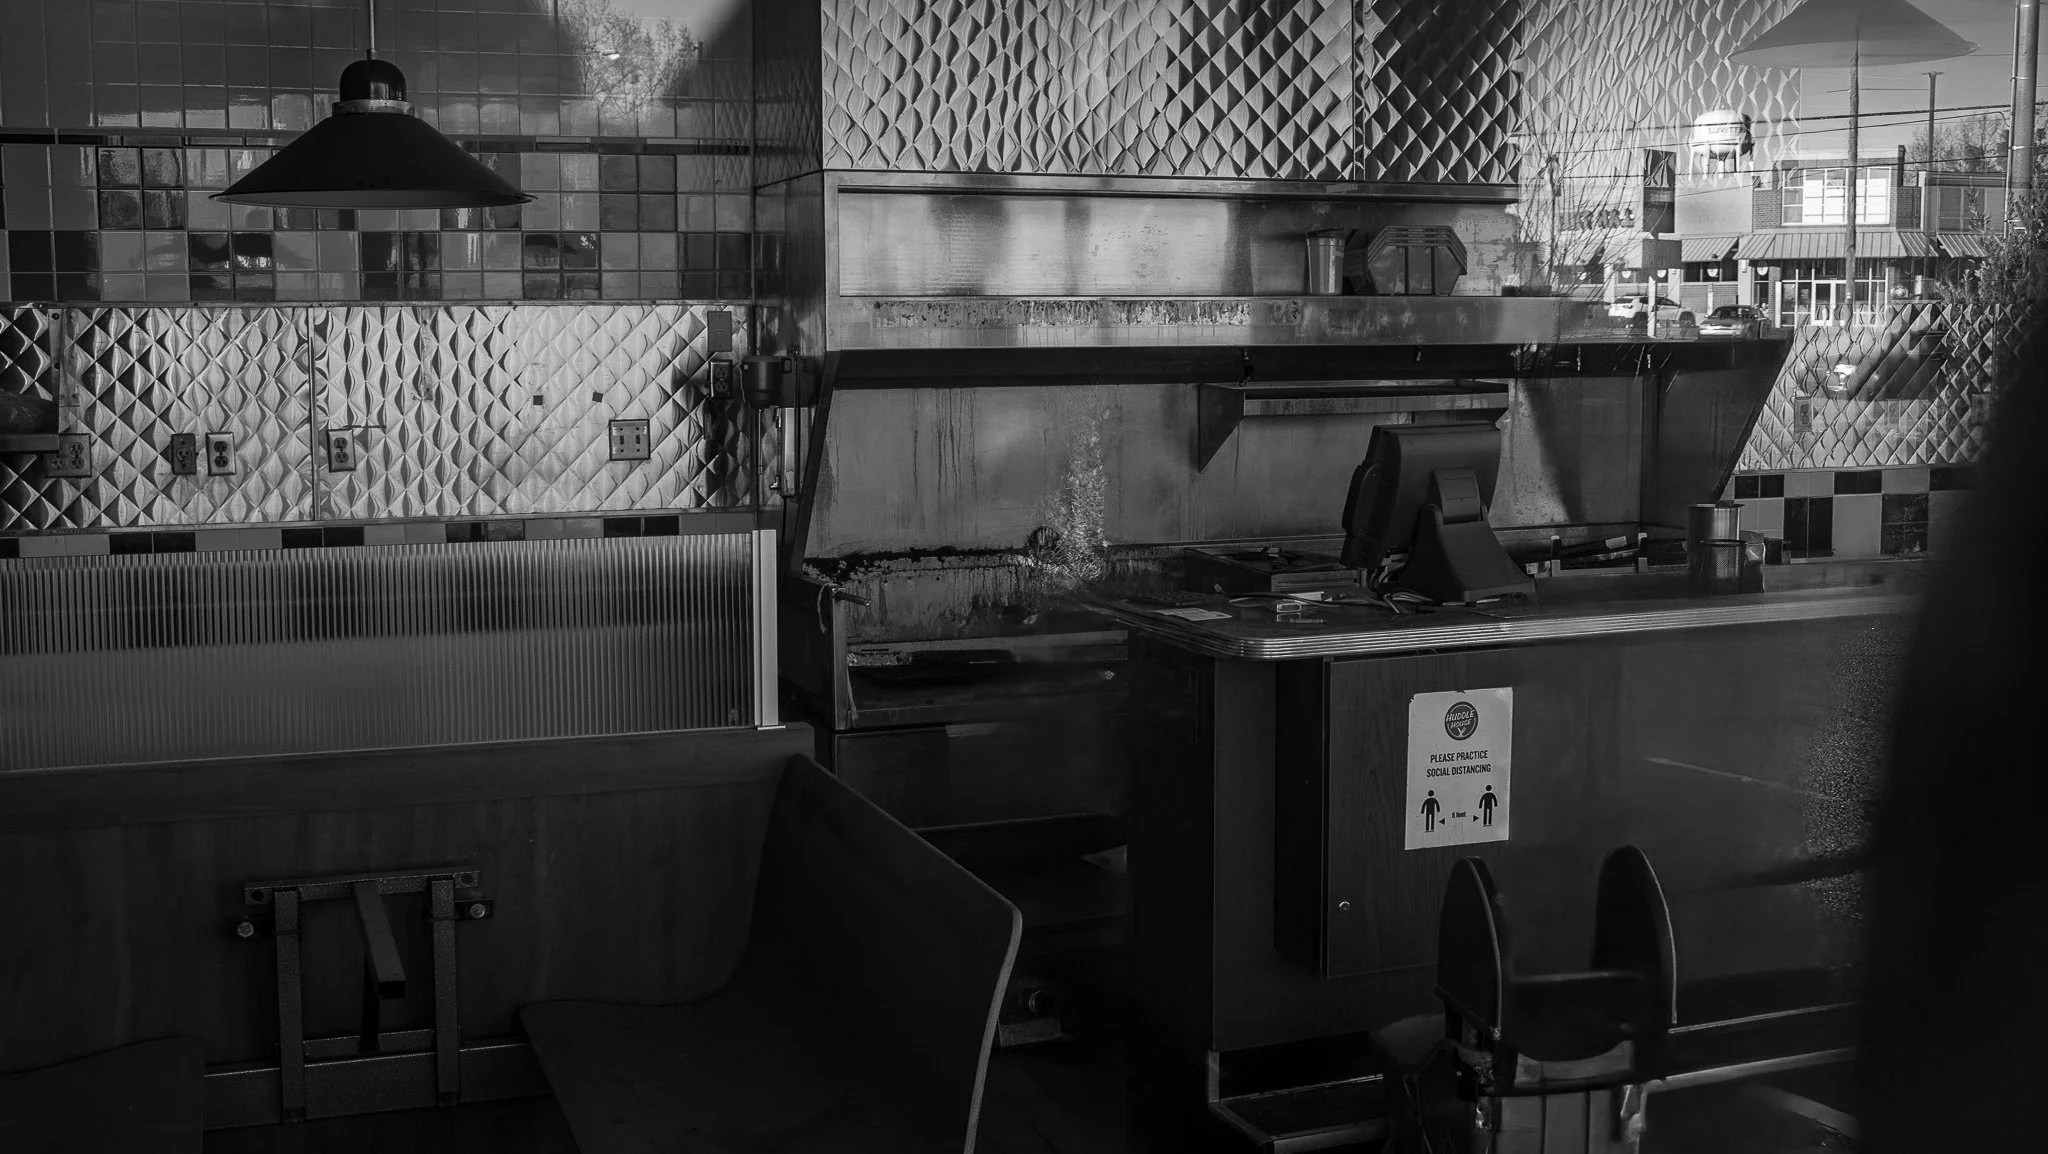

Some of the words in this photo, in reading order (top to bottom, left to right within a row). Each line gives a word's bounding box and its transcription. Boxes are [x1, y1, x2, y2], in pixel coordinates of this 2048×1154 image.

[1446, 710, 1475, 722] HUDDLE
[1450, 718, 1472, 728] HOUSE
[1430, 752, 1455, 763] PLEASE
[1456, 750, 1488, 761] PRACTICE
[1426, 767, 1451, 778] SOCIAL
[1451, 763, 1491, 776] DISTANCING
